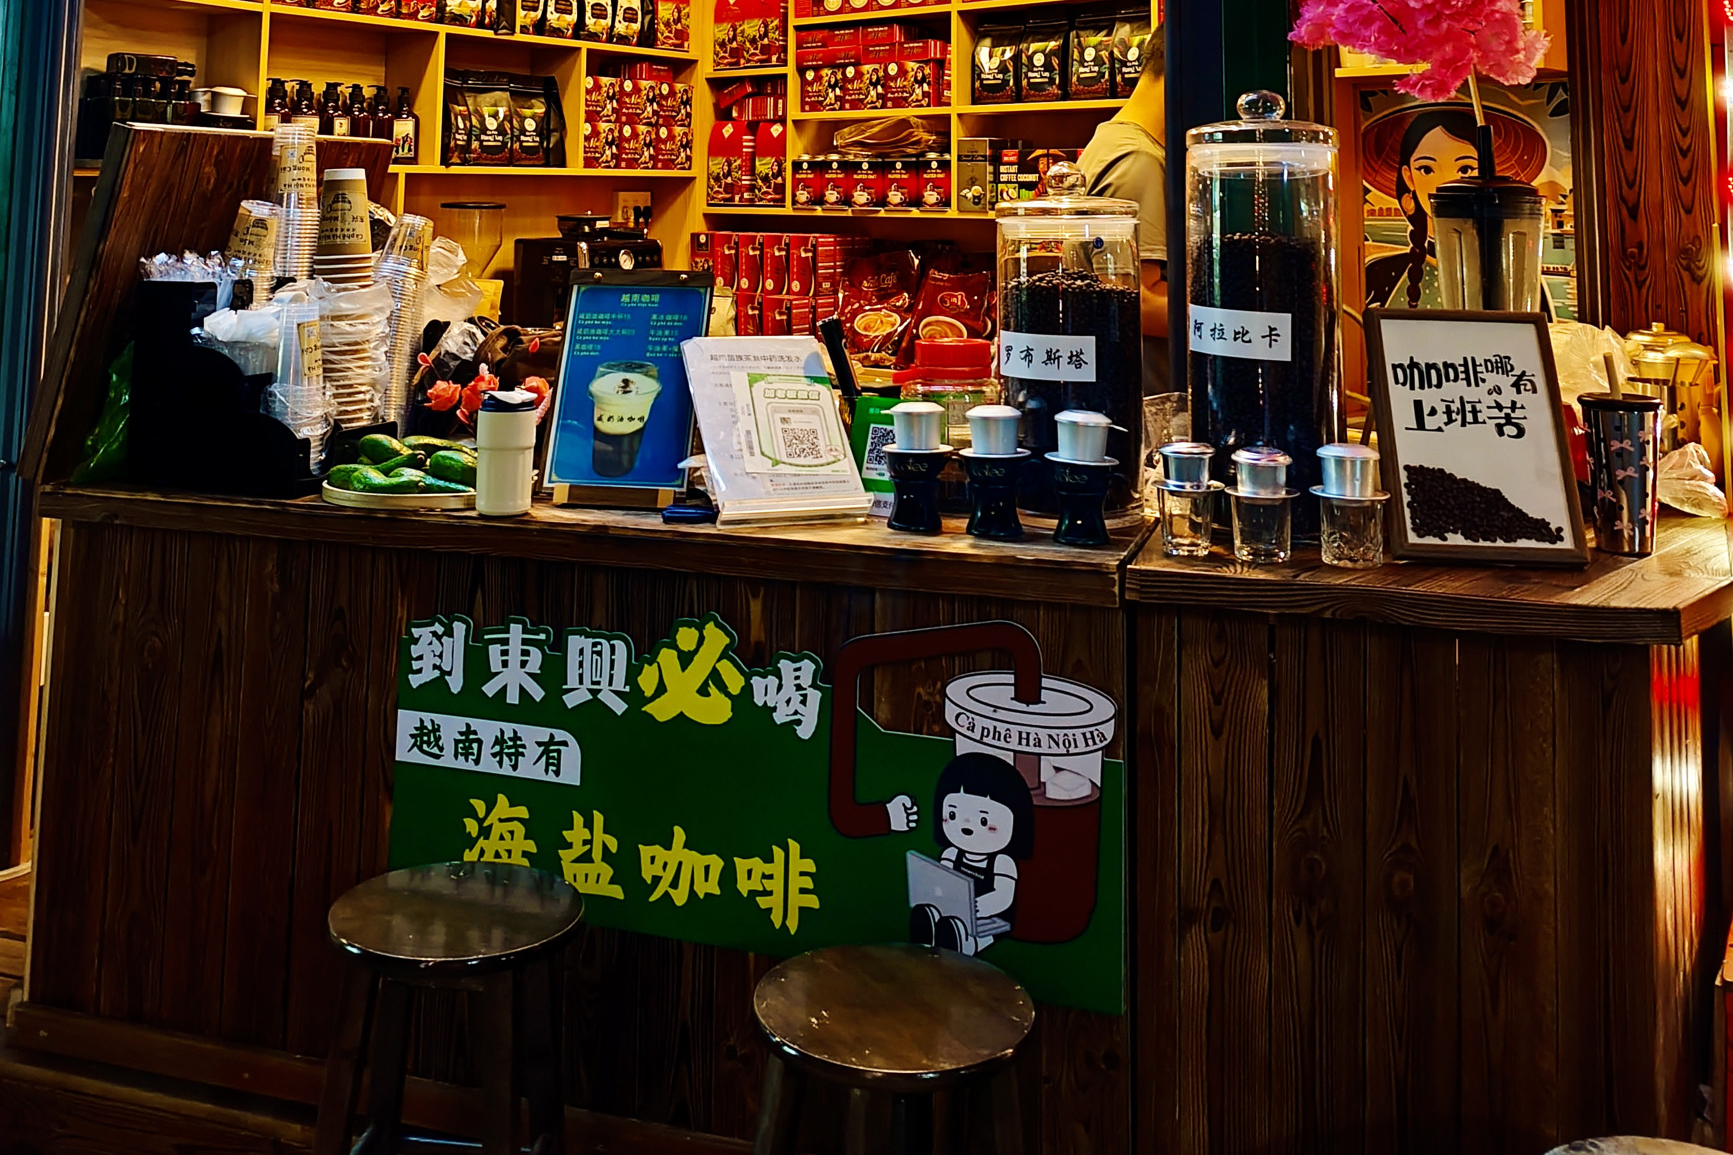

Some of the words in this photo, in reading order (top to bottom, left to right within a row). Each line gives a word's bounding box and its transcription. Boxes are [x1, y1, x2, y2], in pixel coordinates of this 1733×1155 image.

[1000, 165, 1018, 174] INSTANT
[1000, 174, 1017, 182] COFFEE
[1018, 174, 1039, 182] COCONUT
[1193, 318, 1281, 349] 阿拉比卡
[1004, 344, 1089, 371] 罗布斯塔
[1404, 395, 1528, 439] 上班苦
[408, 621, 823, 740] 到東興必喝
[407, 717, 569, 778] 越南特有
[955, 711, 976, 733] Cà
[979, 725, 1012, 744] phê
[1017, 731, 1043, 749] Hà
[1047, 730, 1078, 754] Nội
[1081, 728, 1108, 747] Hà
[463, 793, 820, 935] 海盐咖啡
